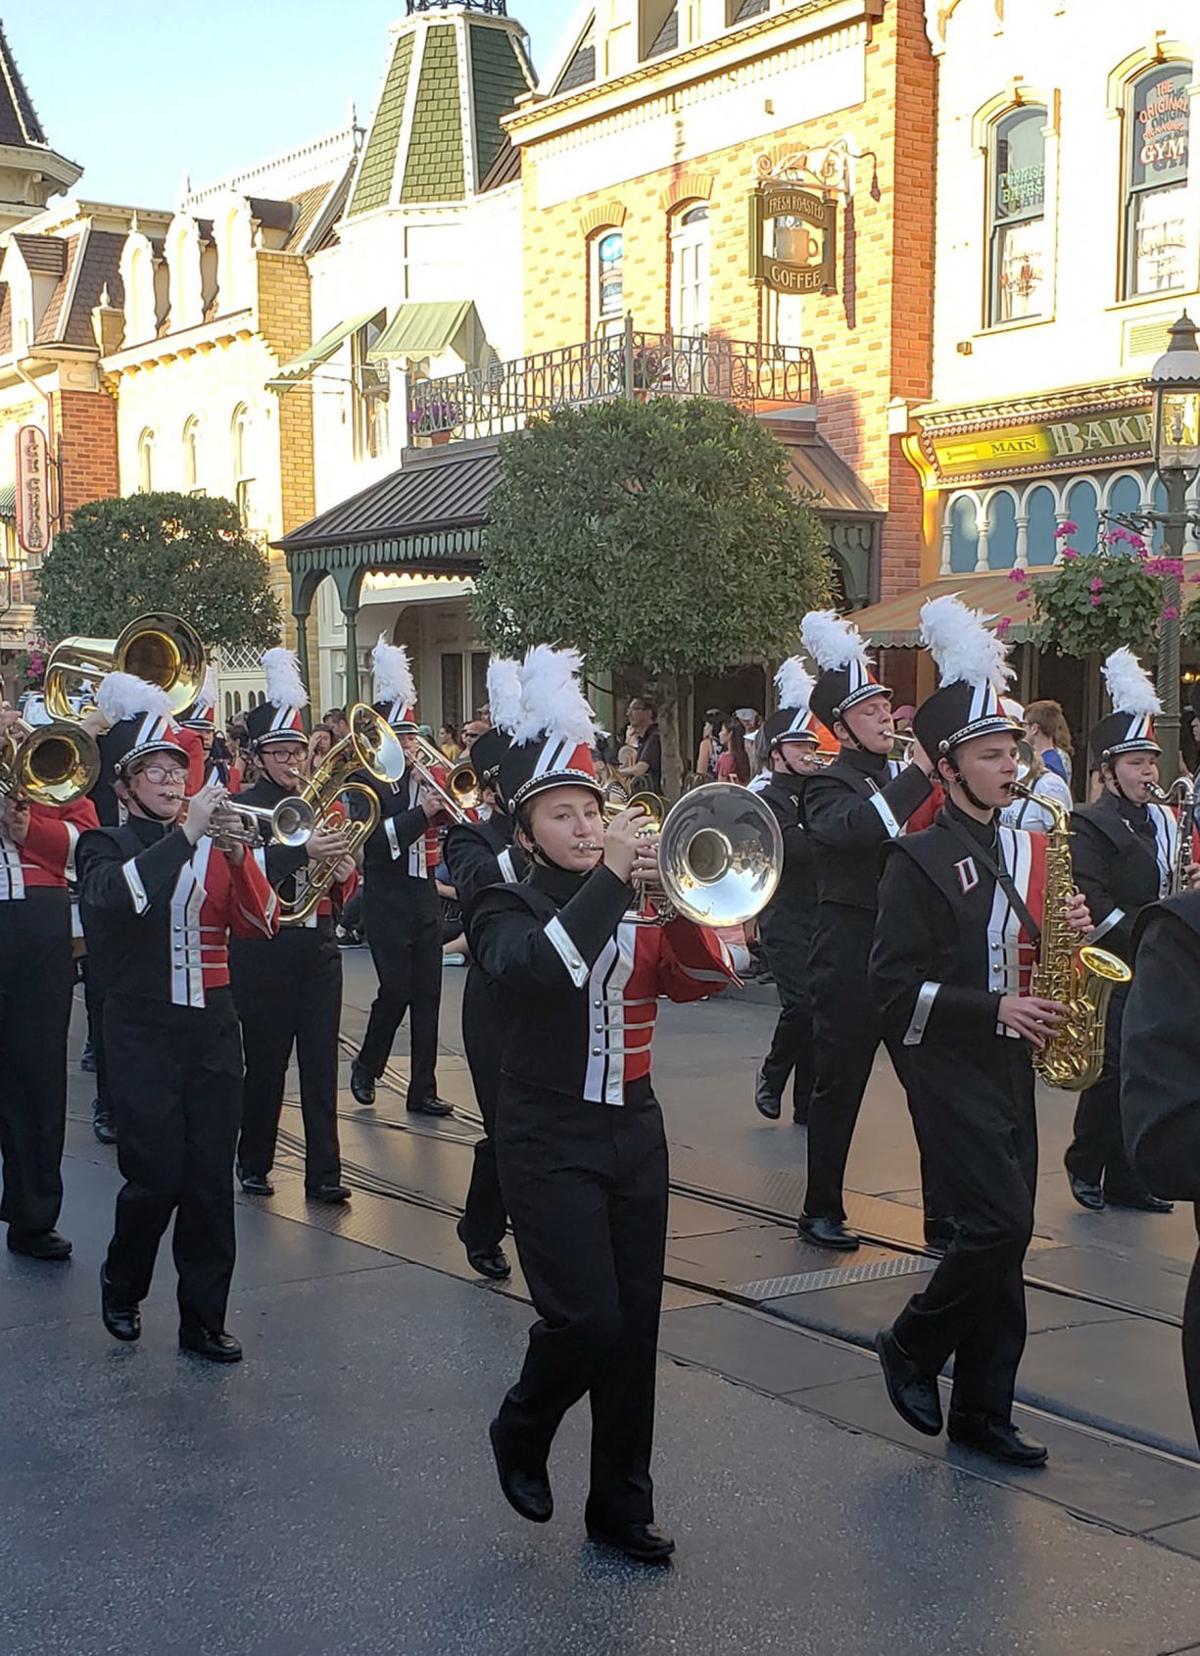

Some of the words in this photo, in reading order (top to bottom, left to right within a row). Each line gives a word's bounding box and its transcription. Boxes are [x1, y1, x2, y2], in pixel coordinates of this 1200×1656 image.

[1155, 80, 1174, 97] THE
[1139, 96, 1188, 123] ORIGINAL
[1140, 137, 1185, 164] GYM
[769, 196, 791, 213] FRESH
[792, 196, 824, 220] ROASTED
[771, 265, 821, 289] COFFEE
[991, 436, 1037, 455] MAIN
[953, 856, 979, 895] D
